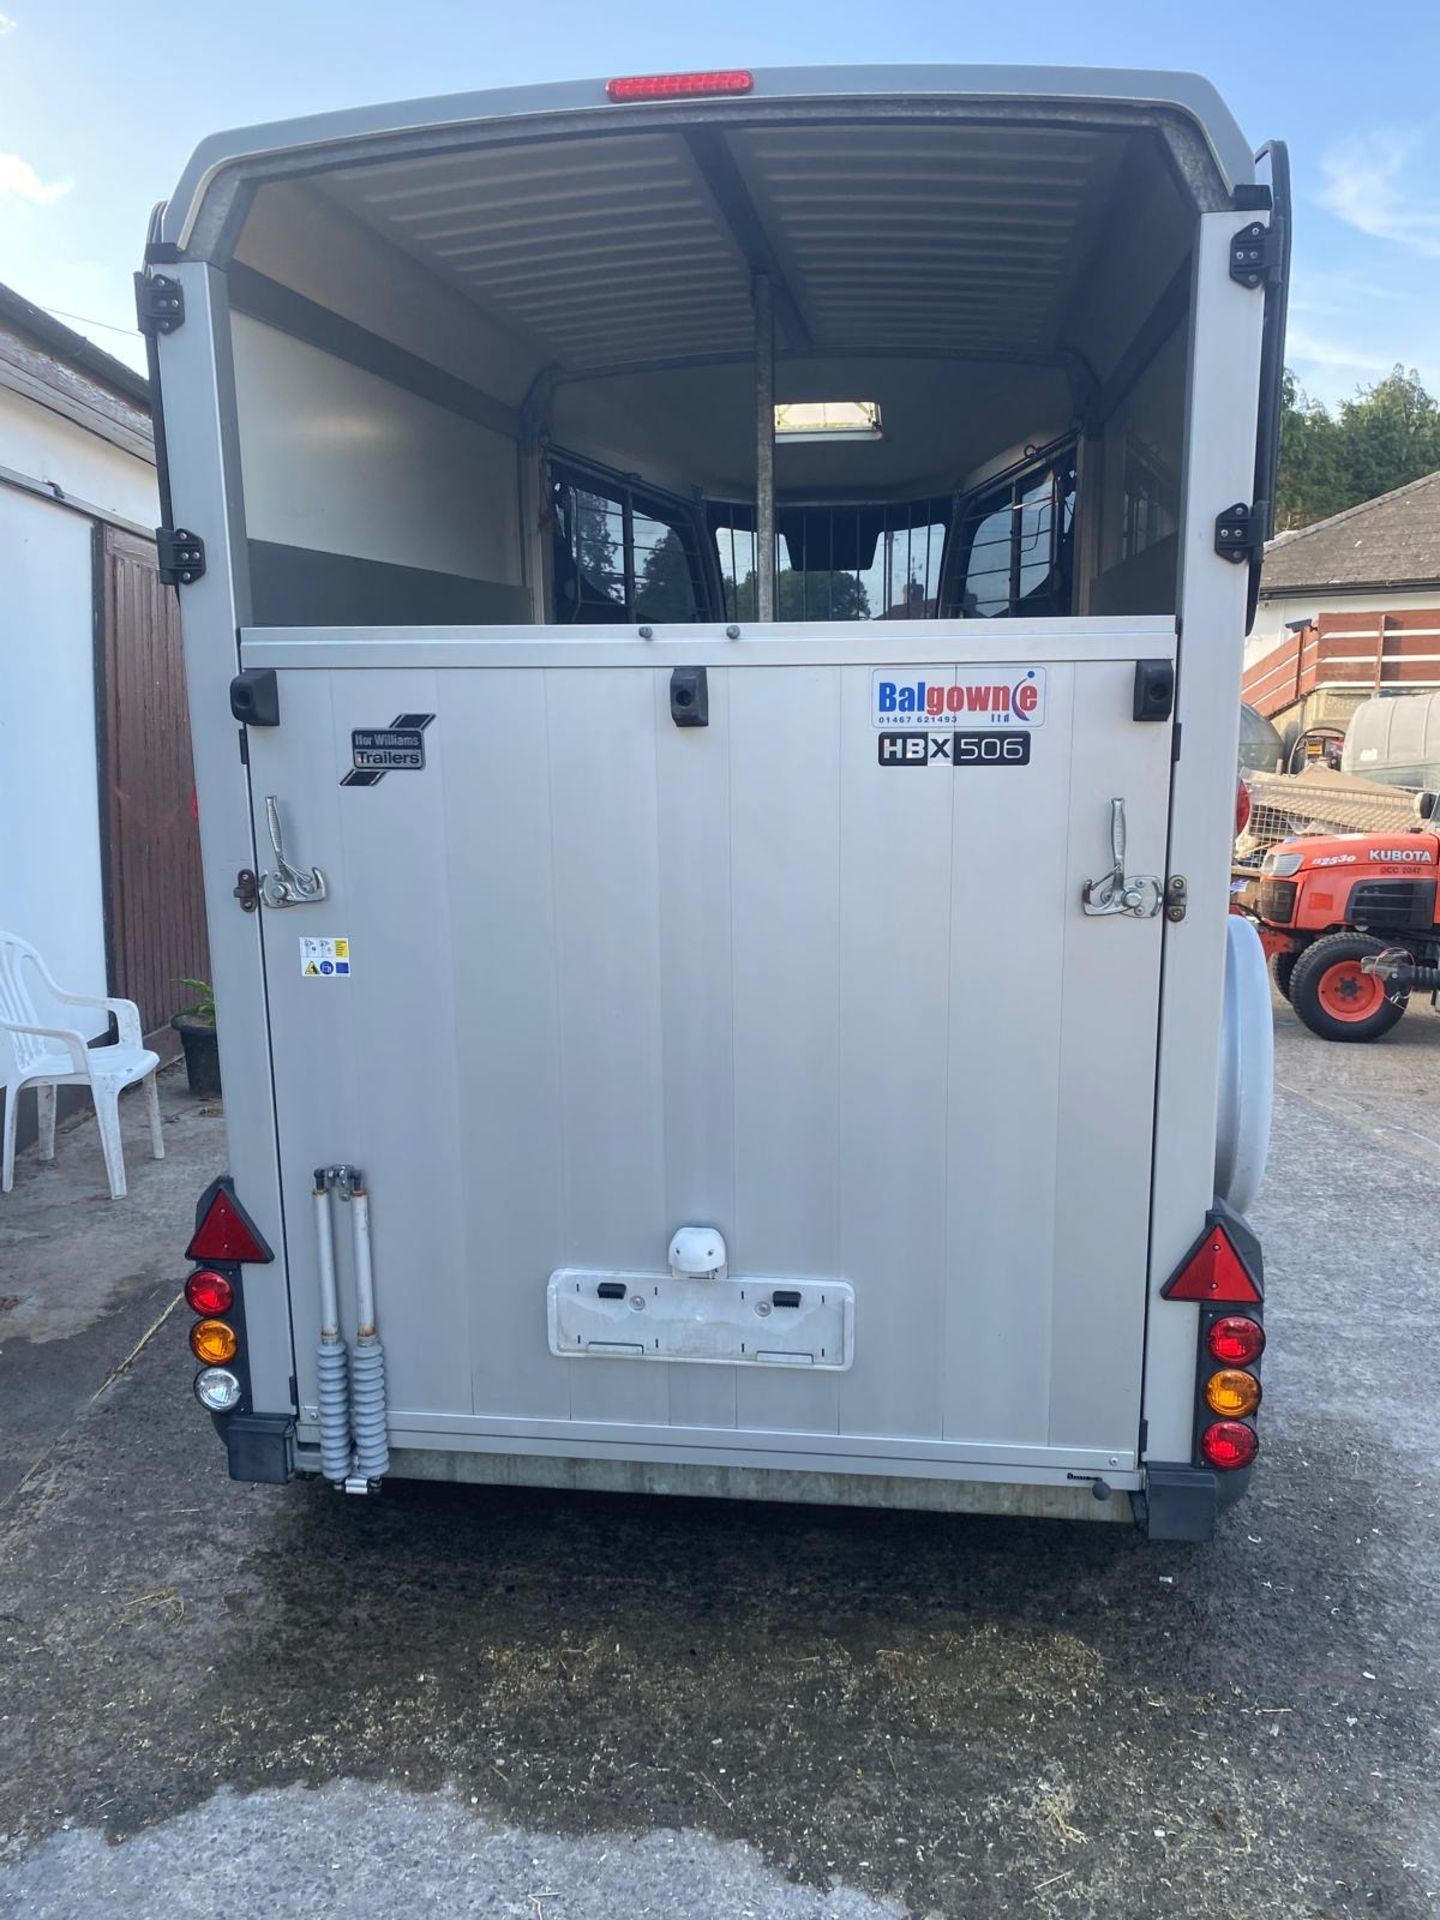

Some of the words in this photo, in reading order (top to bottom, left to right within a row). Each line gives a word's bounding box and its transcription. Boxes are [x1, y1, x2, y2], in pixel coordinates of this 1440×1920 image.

[878, 671, 1038, 721] Balgownie
[878, 716, 912, 724] 01467
[916, 715, 958, 724] 621493
[374, 734, 420, 746] Williams
[356, 751, 420, 764] Trailers
[1369, 850, 1432, 863] KUBOTA
